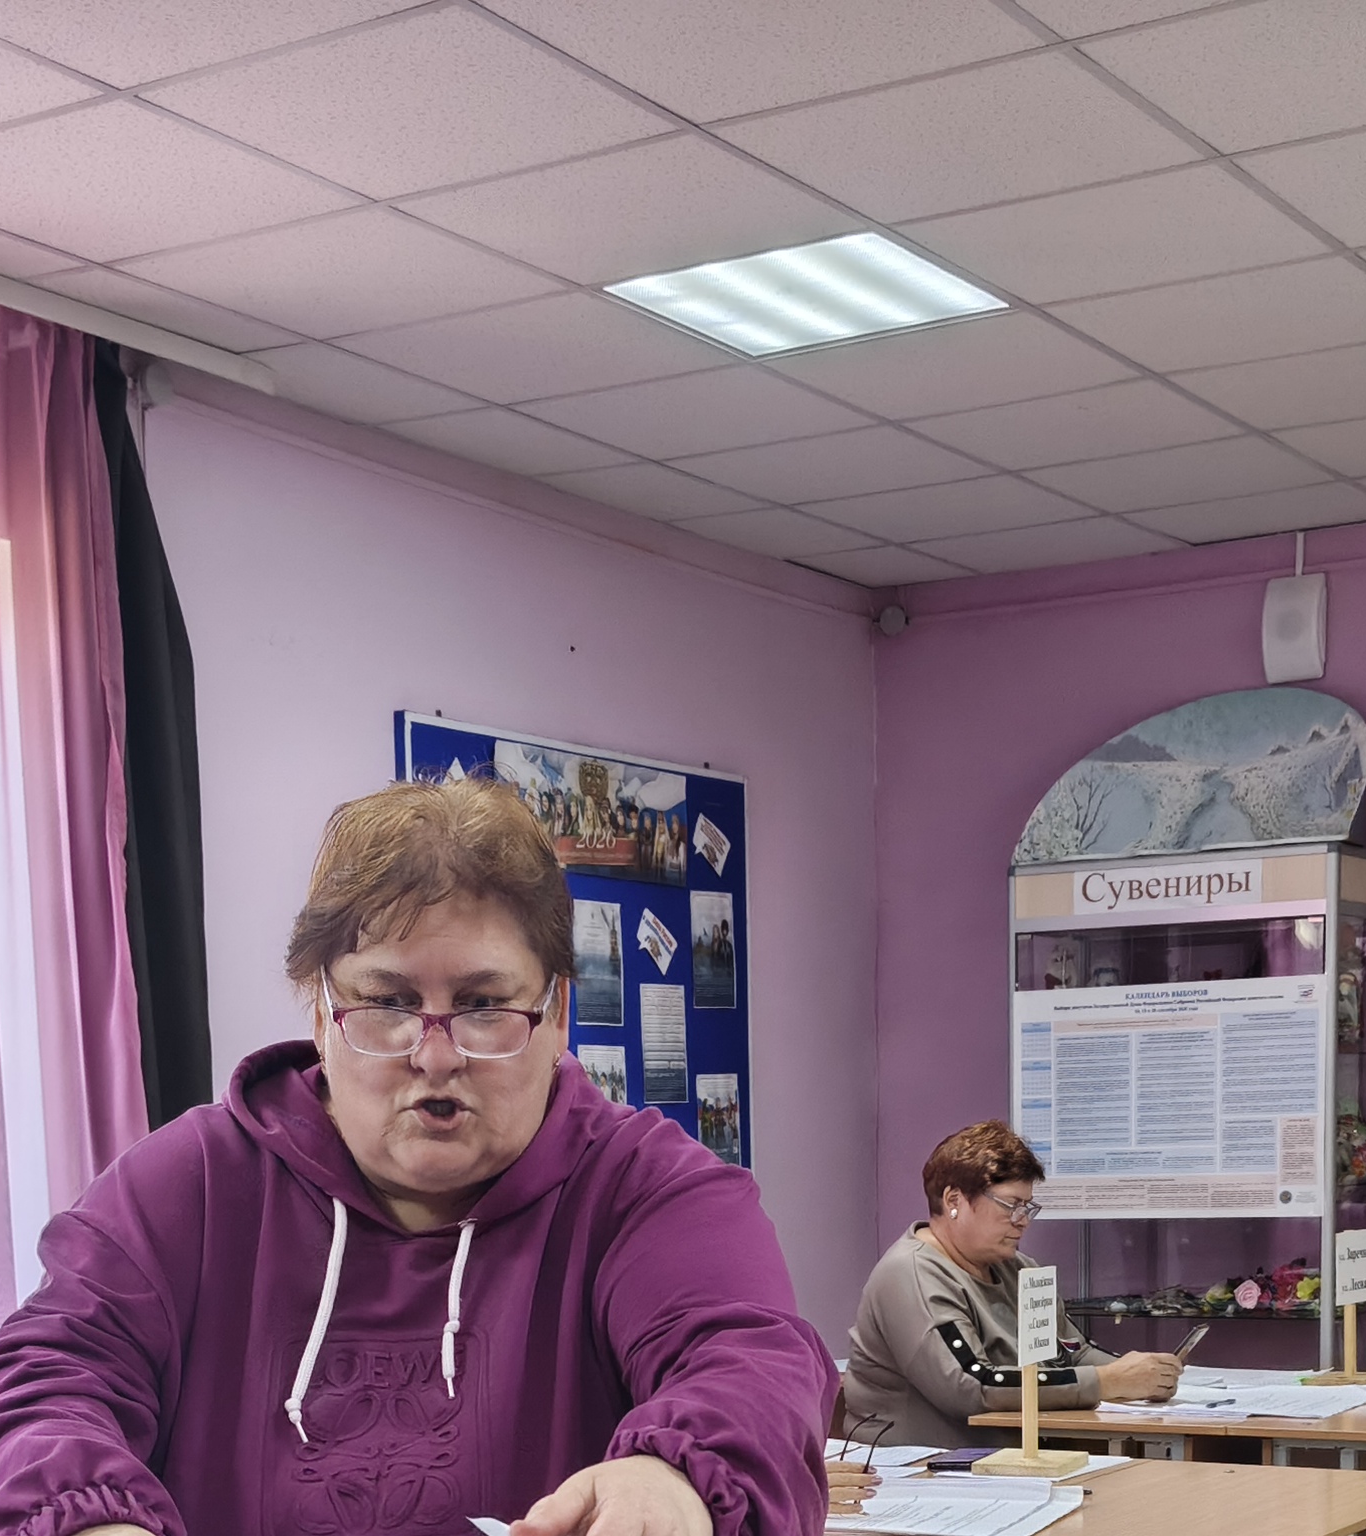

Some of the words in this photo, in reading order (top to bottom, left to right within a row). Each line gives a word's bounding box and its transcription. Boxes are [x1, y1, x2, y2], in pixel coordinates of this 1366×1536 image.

[576, 830, 616, 848] 2026
[1080, 870, 1253, 909] Сувениры
[1125, 991, 1169, 1001] КАЛЕНДАРЬ
[1171, 989, 1209, 999] ВЫБОРОВ
